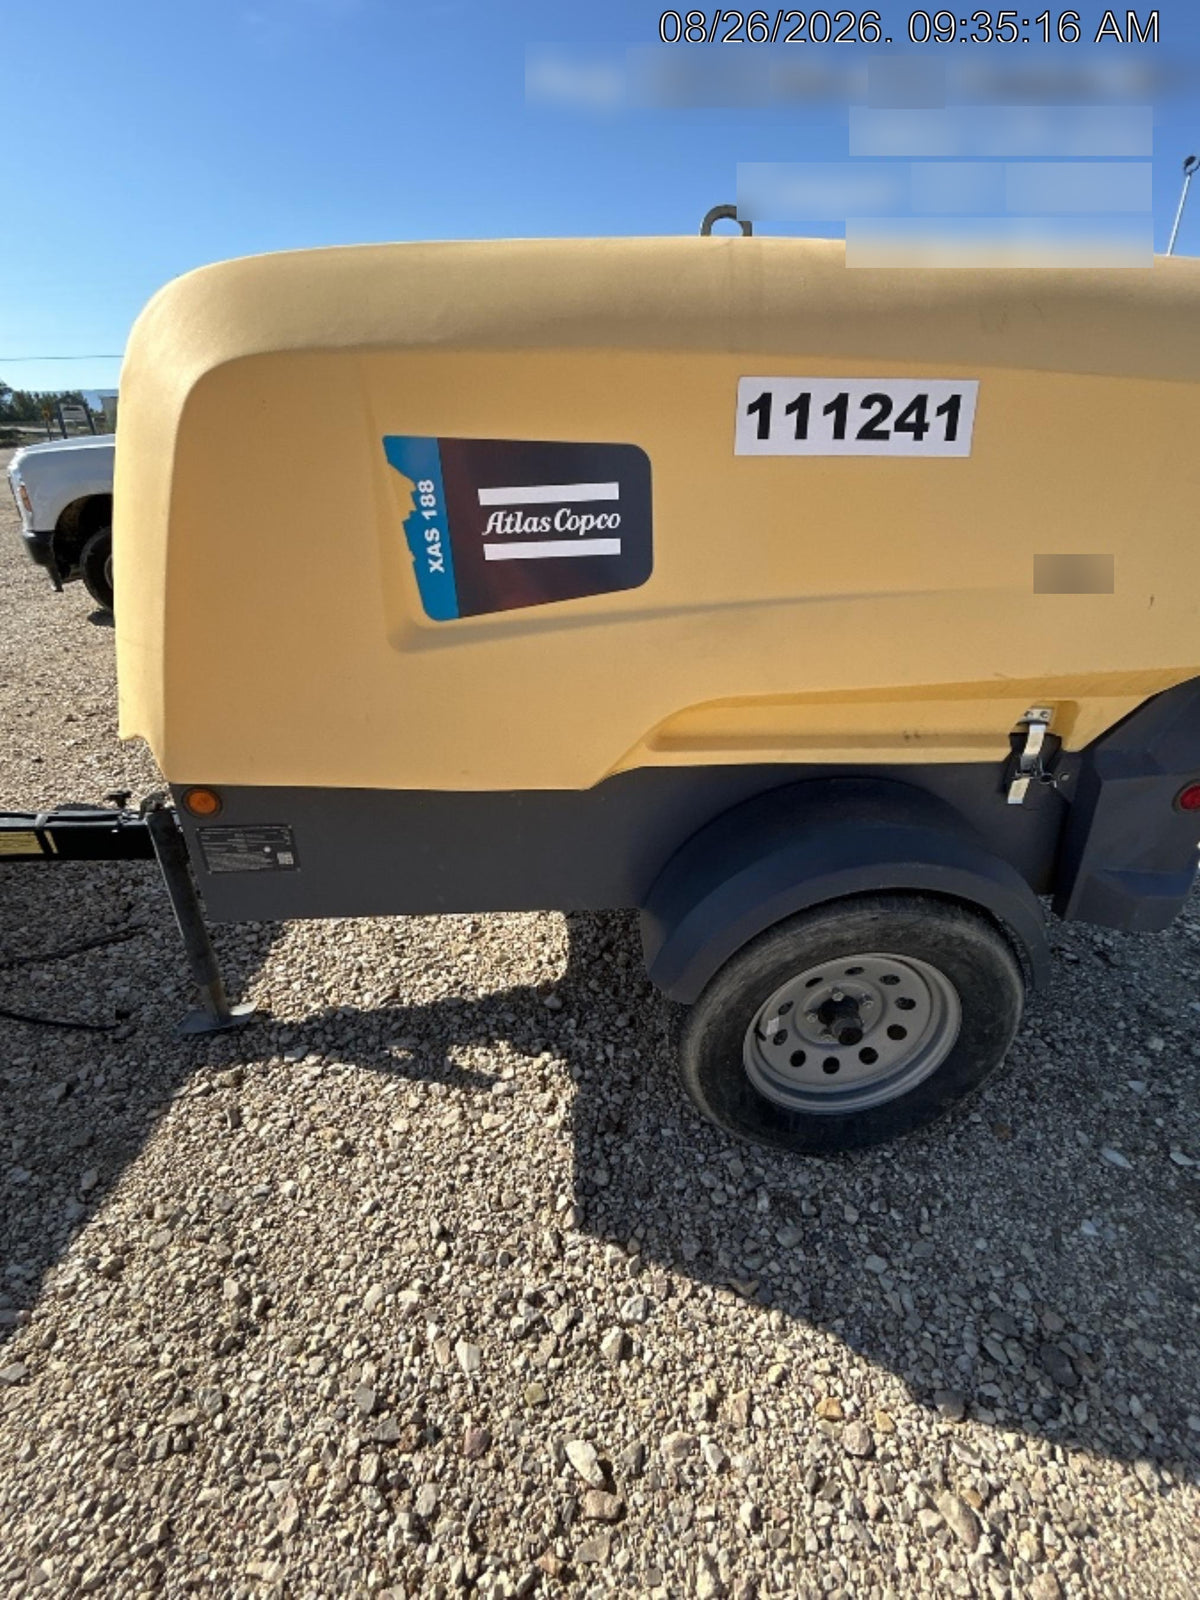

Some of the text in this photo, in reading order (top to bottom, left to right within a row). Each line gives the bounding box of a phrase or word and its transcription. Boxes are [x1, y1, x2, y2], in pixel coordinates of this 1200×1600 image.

[746, 392, 962, 442] 111241
[417, 479, 445, 573] XAS 188
[481, 508, 621, 536] Atlas Copco
